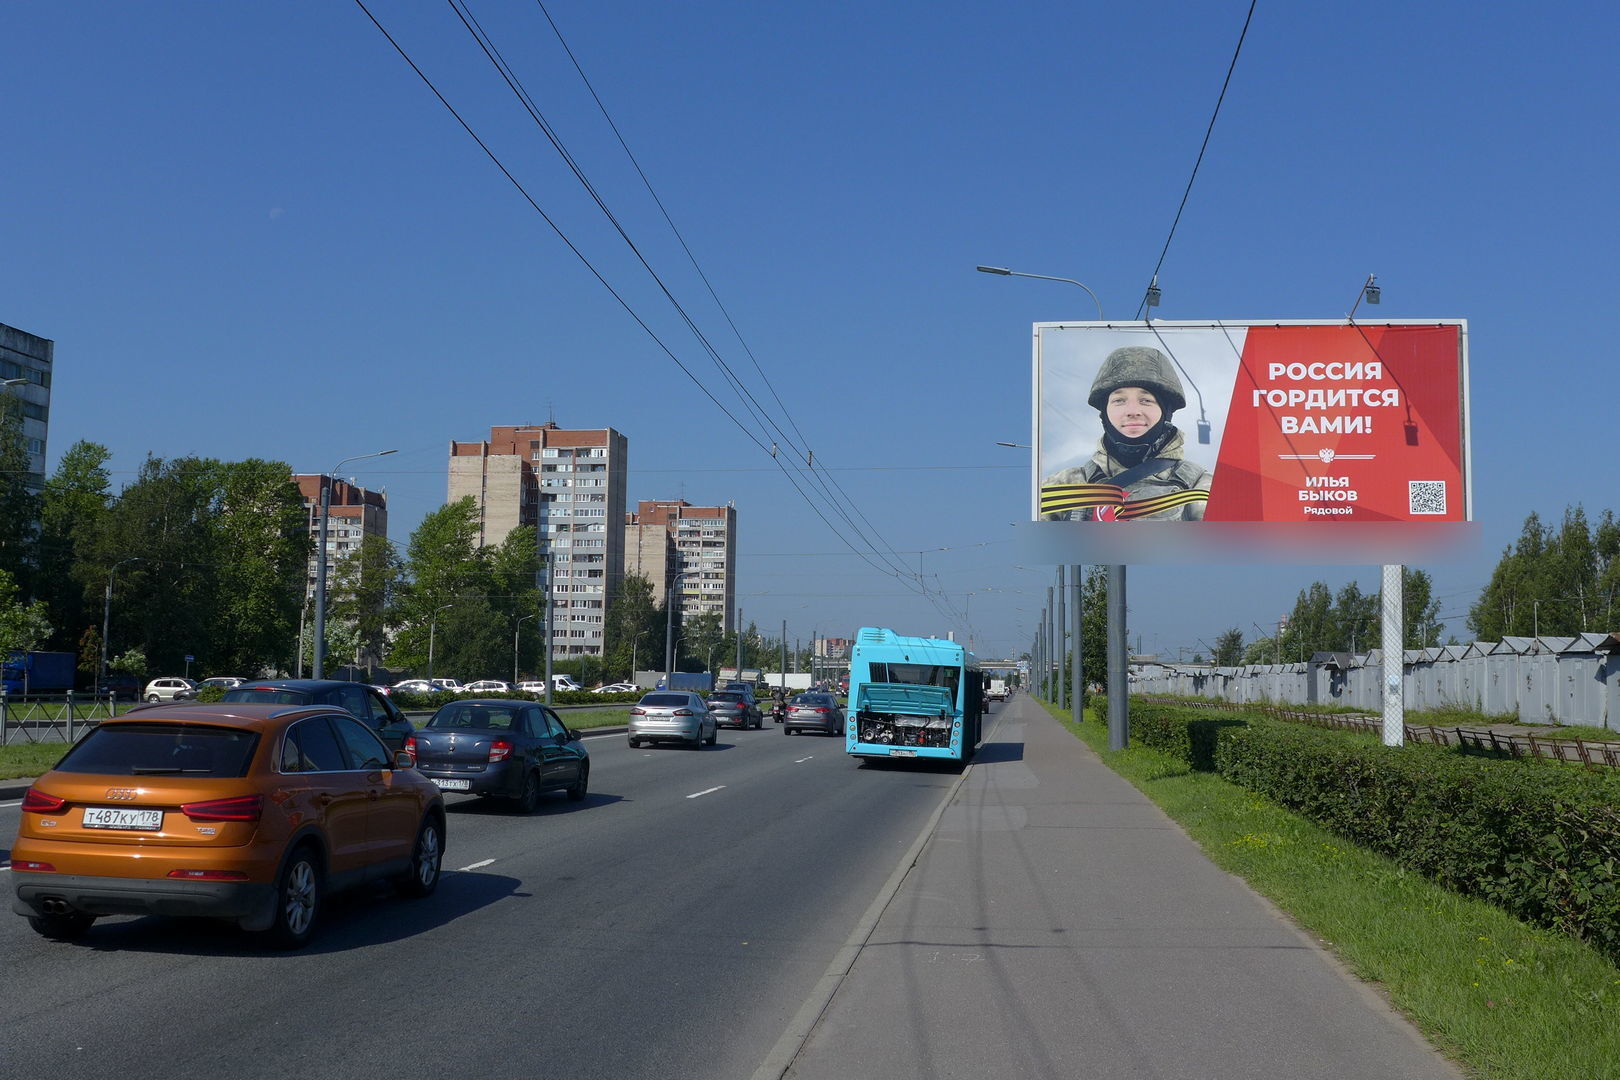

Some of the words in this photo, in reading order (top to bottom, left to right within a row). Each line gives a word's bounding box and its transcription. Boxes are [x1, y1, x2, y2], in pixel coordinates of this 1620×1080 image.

[1268, 361, 1382, 381] РОССИЯ
[1252, 388, 1399, 411] ГОРДИТСЯ
[1281, 415, 1373, 435] ВАМИ!
[1305, 476, 1350, 488] ИЛЬЯ
[1298, 489, 1358, 502] БЫКОВ
[1303, 505, 1353, 516] Рядовой
[140, 811, 160, 823] 178
